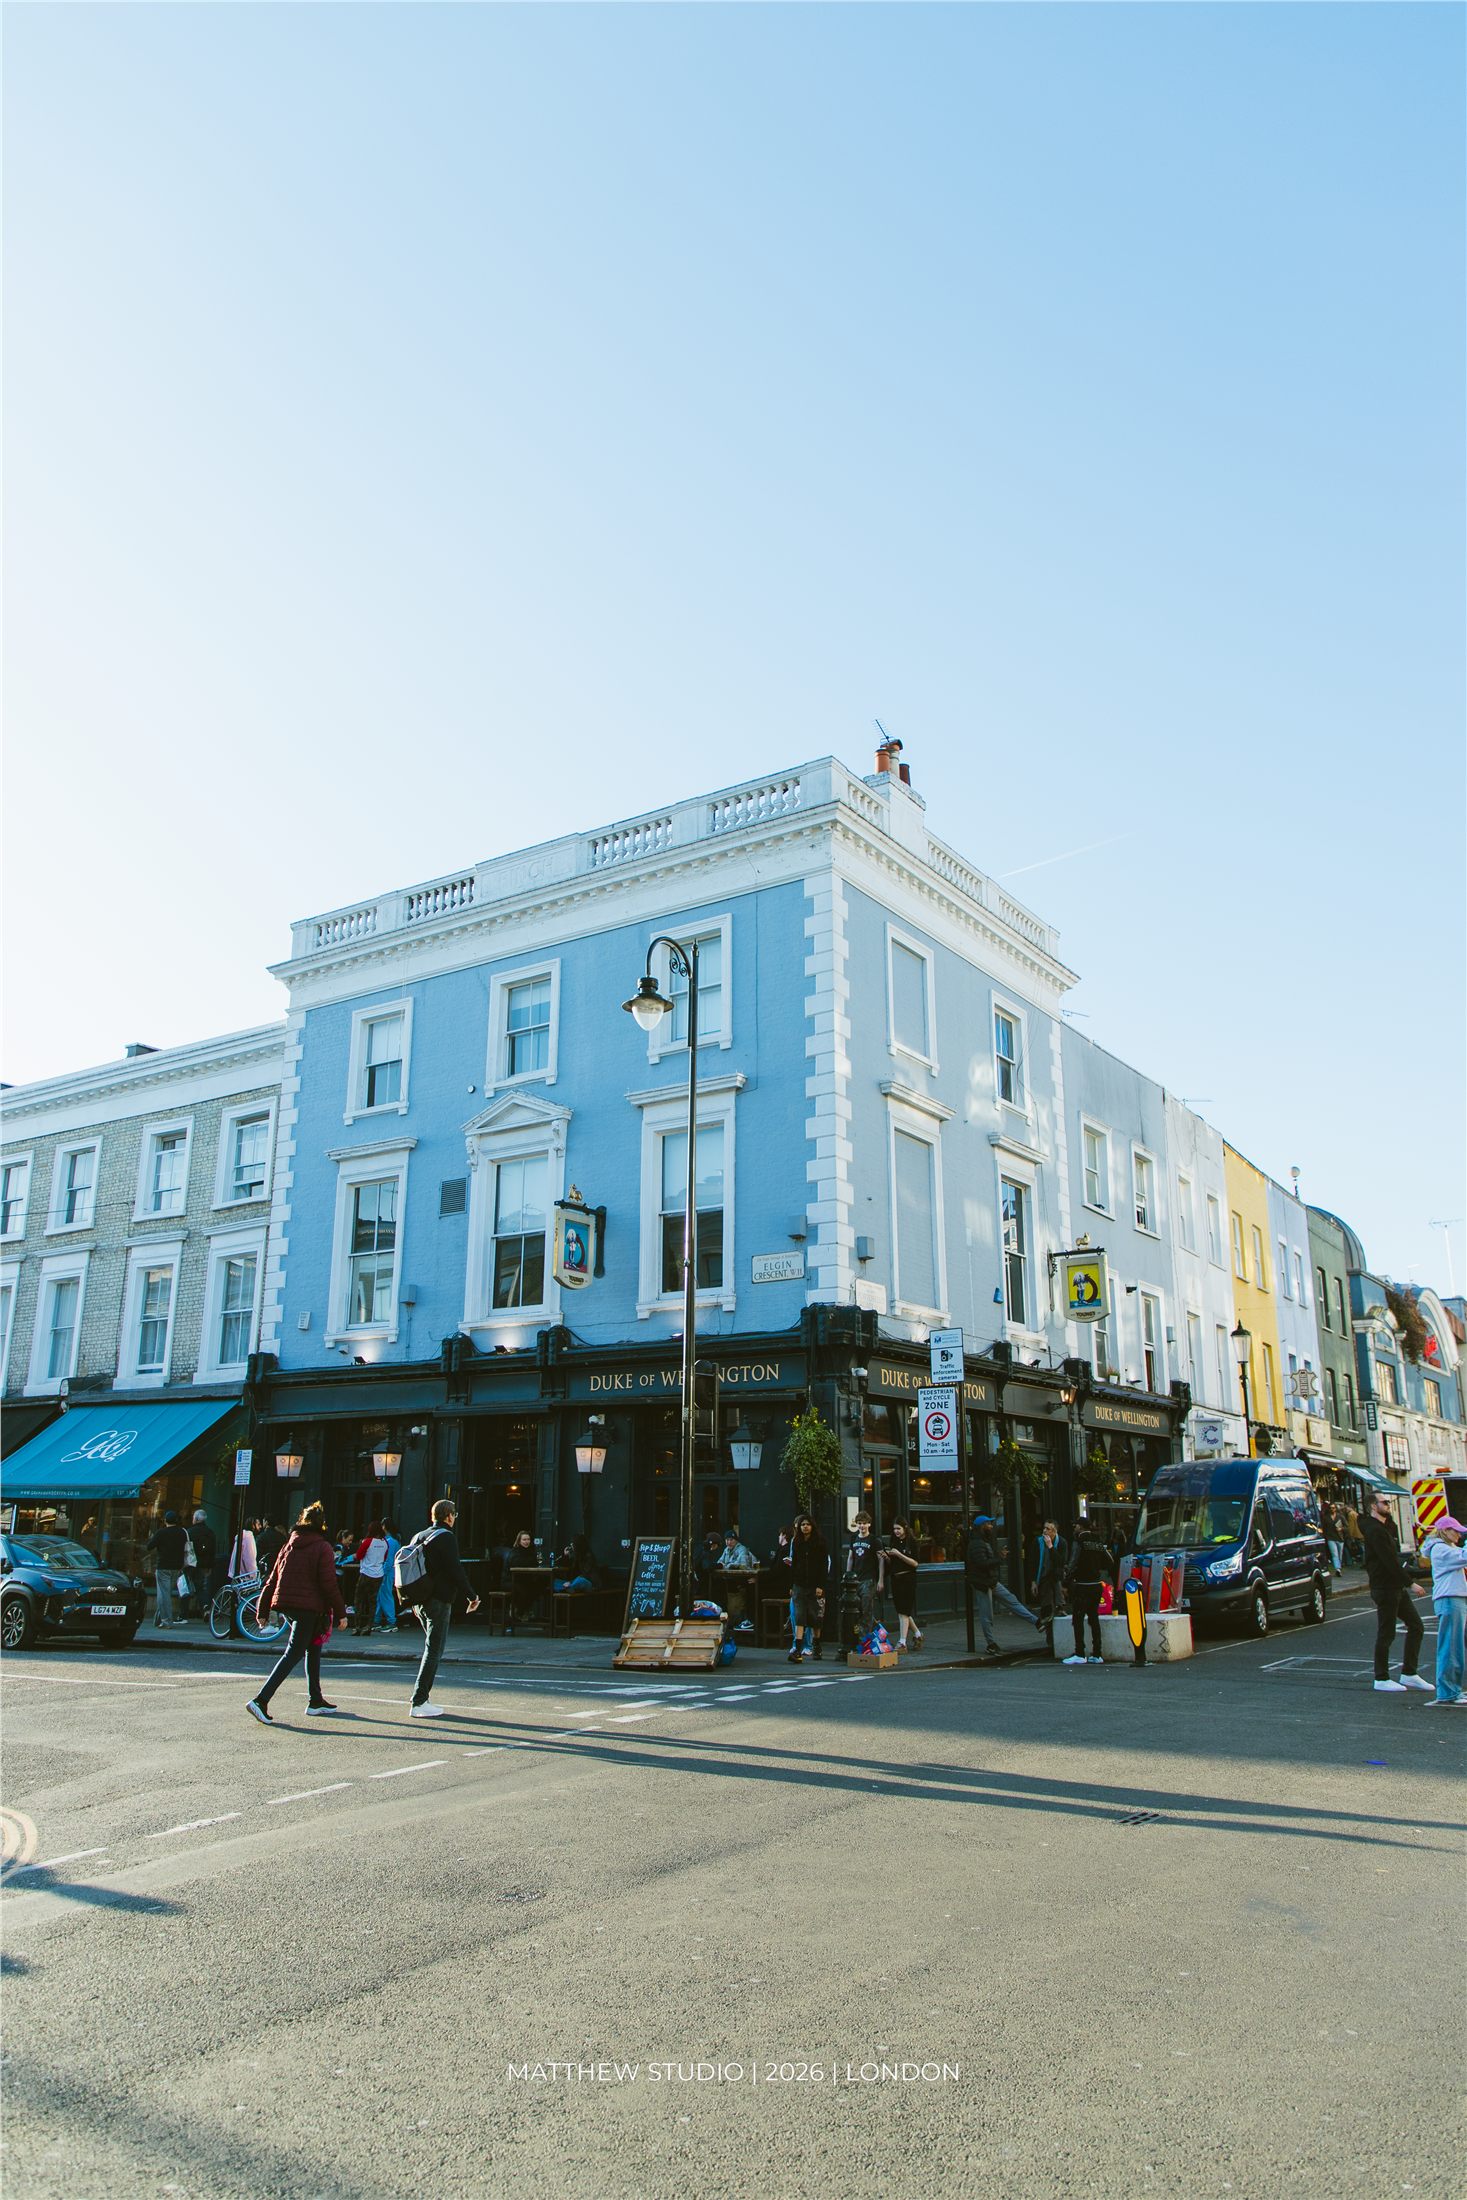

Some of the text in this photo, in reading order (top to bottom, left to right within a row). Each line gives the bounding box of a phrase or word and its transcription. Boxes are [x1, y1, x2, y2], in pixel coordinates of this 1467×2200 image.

[763, 1260, 792, 1271] ELGIN
[933, 1368, 962, 1376] enforcement
[590, 1373, 633, 1392] DUKE
[639, 1373, 655, 1387] OF
[881, 1368, 910, 1389] DUKE
[912, 1376, 922, 1388] OF
[920, 1388, 954, 1396] PEDESTRIAN
[925, 1401, 949, 1410] ZONE
[1095, 1406, 1160, 1428] DUKE OF WELLINGTON
[93, 1606, 110, 1614] LG74
